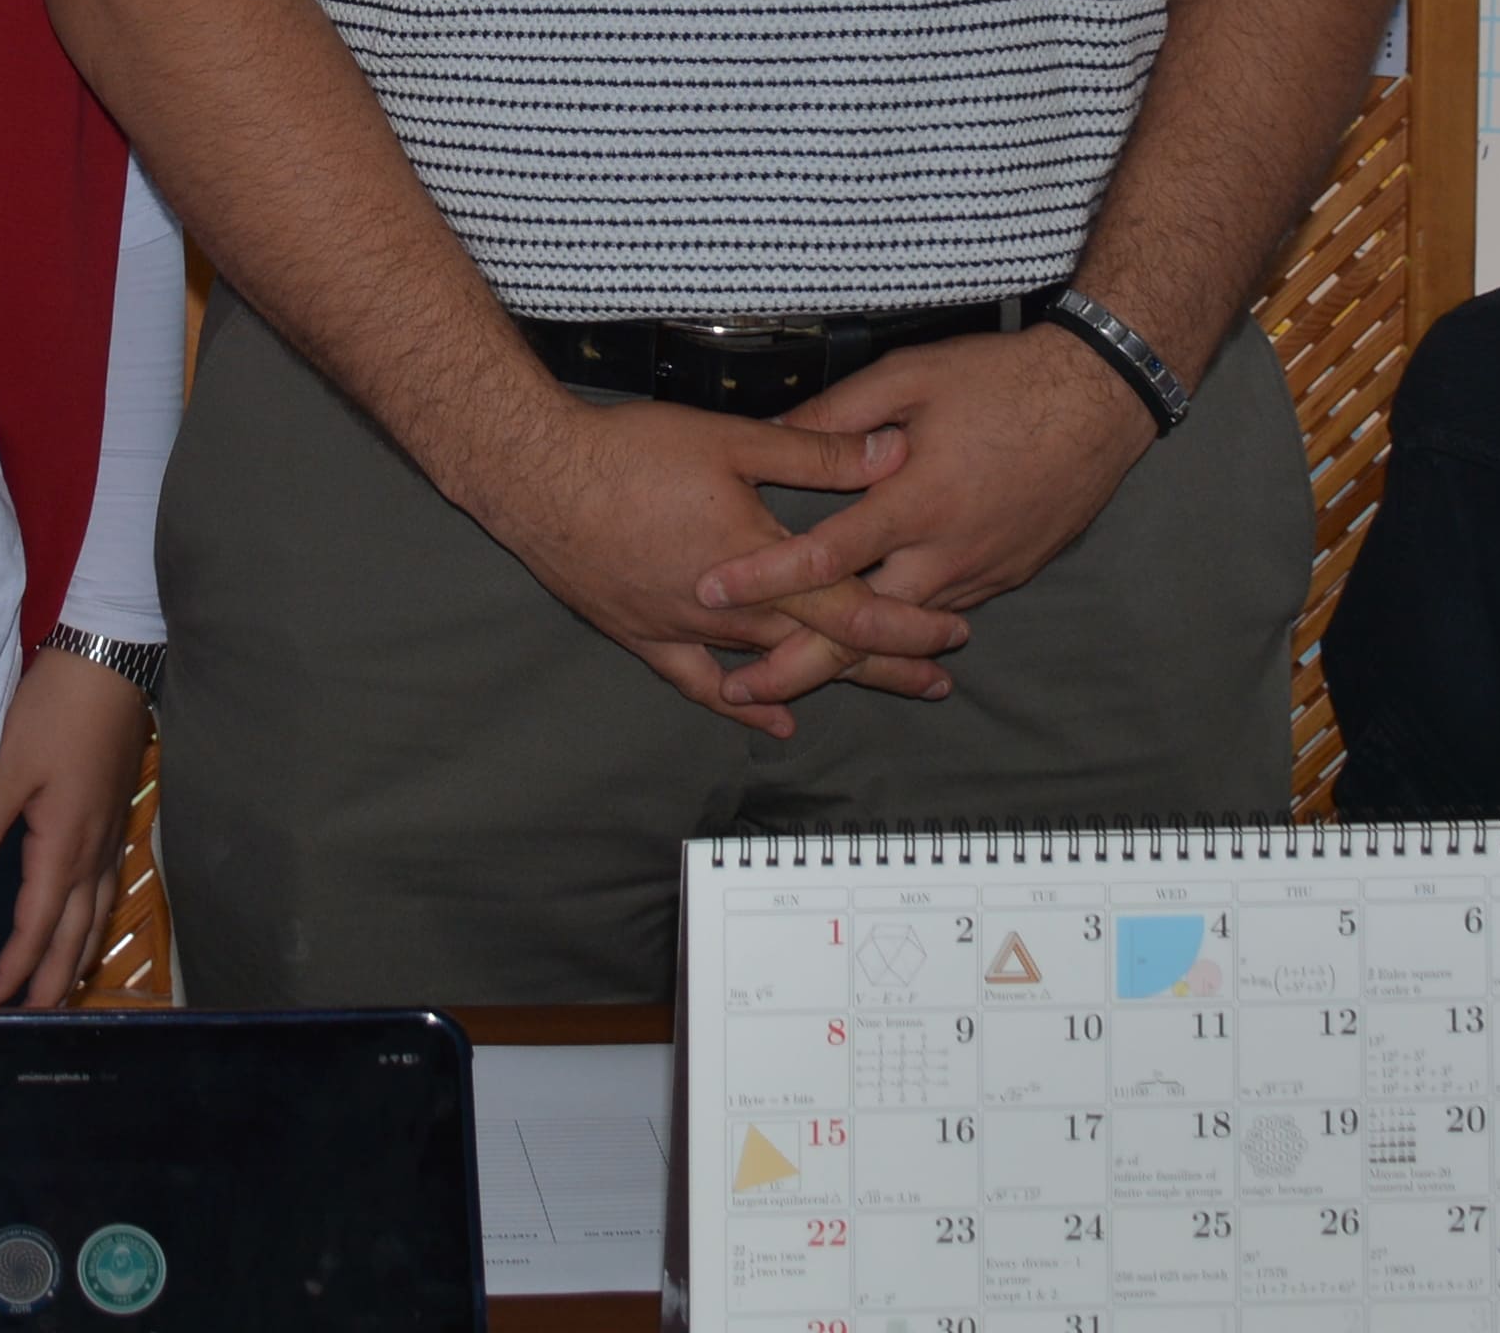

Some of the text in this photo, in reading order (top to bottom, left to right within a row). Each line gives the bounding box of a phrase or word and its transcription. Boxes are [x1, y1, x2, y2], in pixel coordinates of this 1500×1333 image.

[773, 894, 799, 907] SUN
[899, 891, 931, 904] MON
[1030, 890, 1057, 902] TUE
[1155, 888, 1188, 900] WED
[1285, 885, 1312, 898] THU
[1413, 883, 1436, 896] FRI
[827, 918, 844, 945] 1
[955, 916, 974, 943] 2
[1082, 914, 1102, 941] 3
[1209, 912, 1231, 939] 4
[1338, 910, 1356, 936] 5
[1463, 906, 1483, 934] 6
[826, 1017, 846, 1046] 8
[955, 1014, 974, 1044] 9
[1063, 1013, 1102, 1042] 10
[1191, 1012, 1229, 1039] 11
[1318, 1009, 1358, 1037] 12
[1445, 1005, 1484, 1034] 13
[807, 1119, 847, 1147] 15
[935, 1116, 975, 1144] 16
[1063, 1114, 1104, 1142] 17
[1191, 1110, 1232, 1139] 18
[1318, 1108, 1359, 1136] 19
[1445, 1106, 1486, 1133] 20
[806, 1219, 847, 1247] 22
[935, 1216, 976, 1244] 23
[1063, 1213, 1104, 1242] 24
[1191, 1211, 1232, 1239] 25
[1318, 1208, 1360, 1236] 26
[1446, 1206, 1488, 1234] 27
